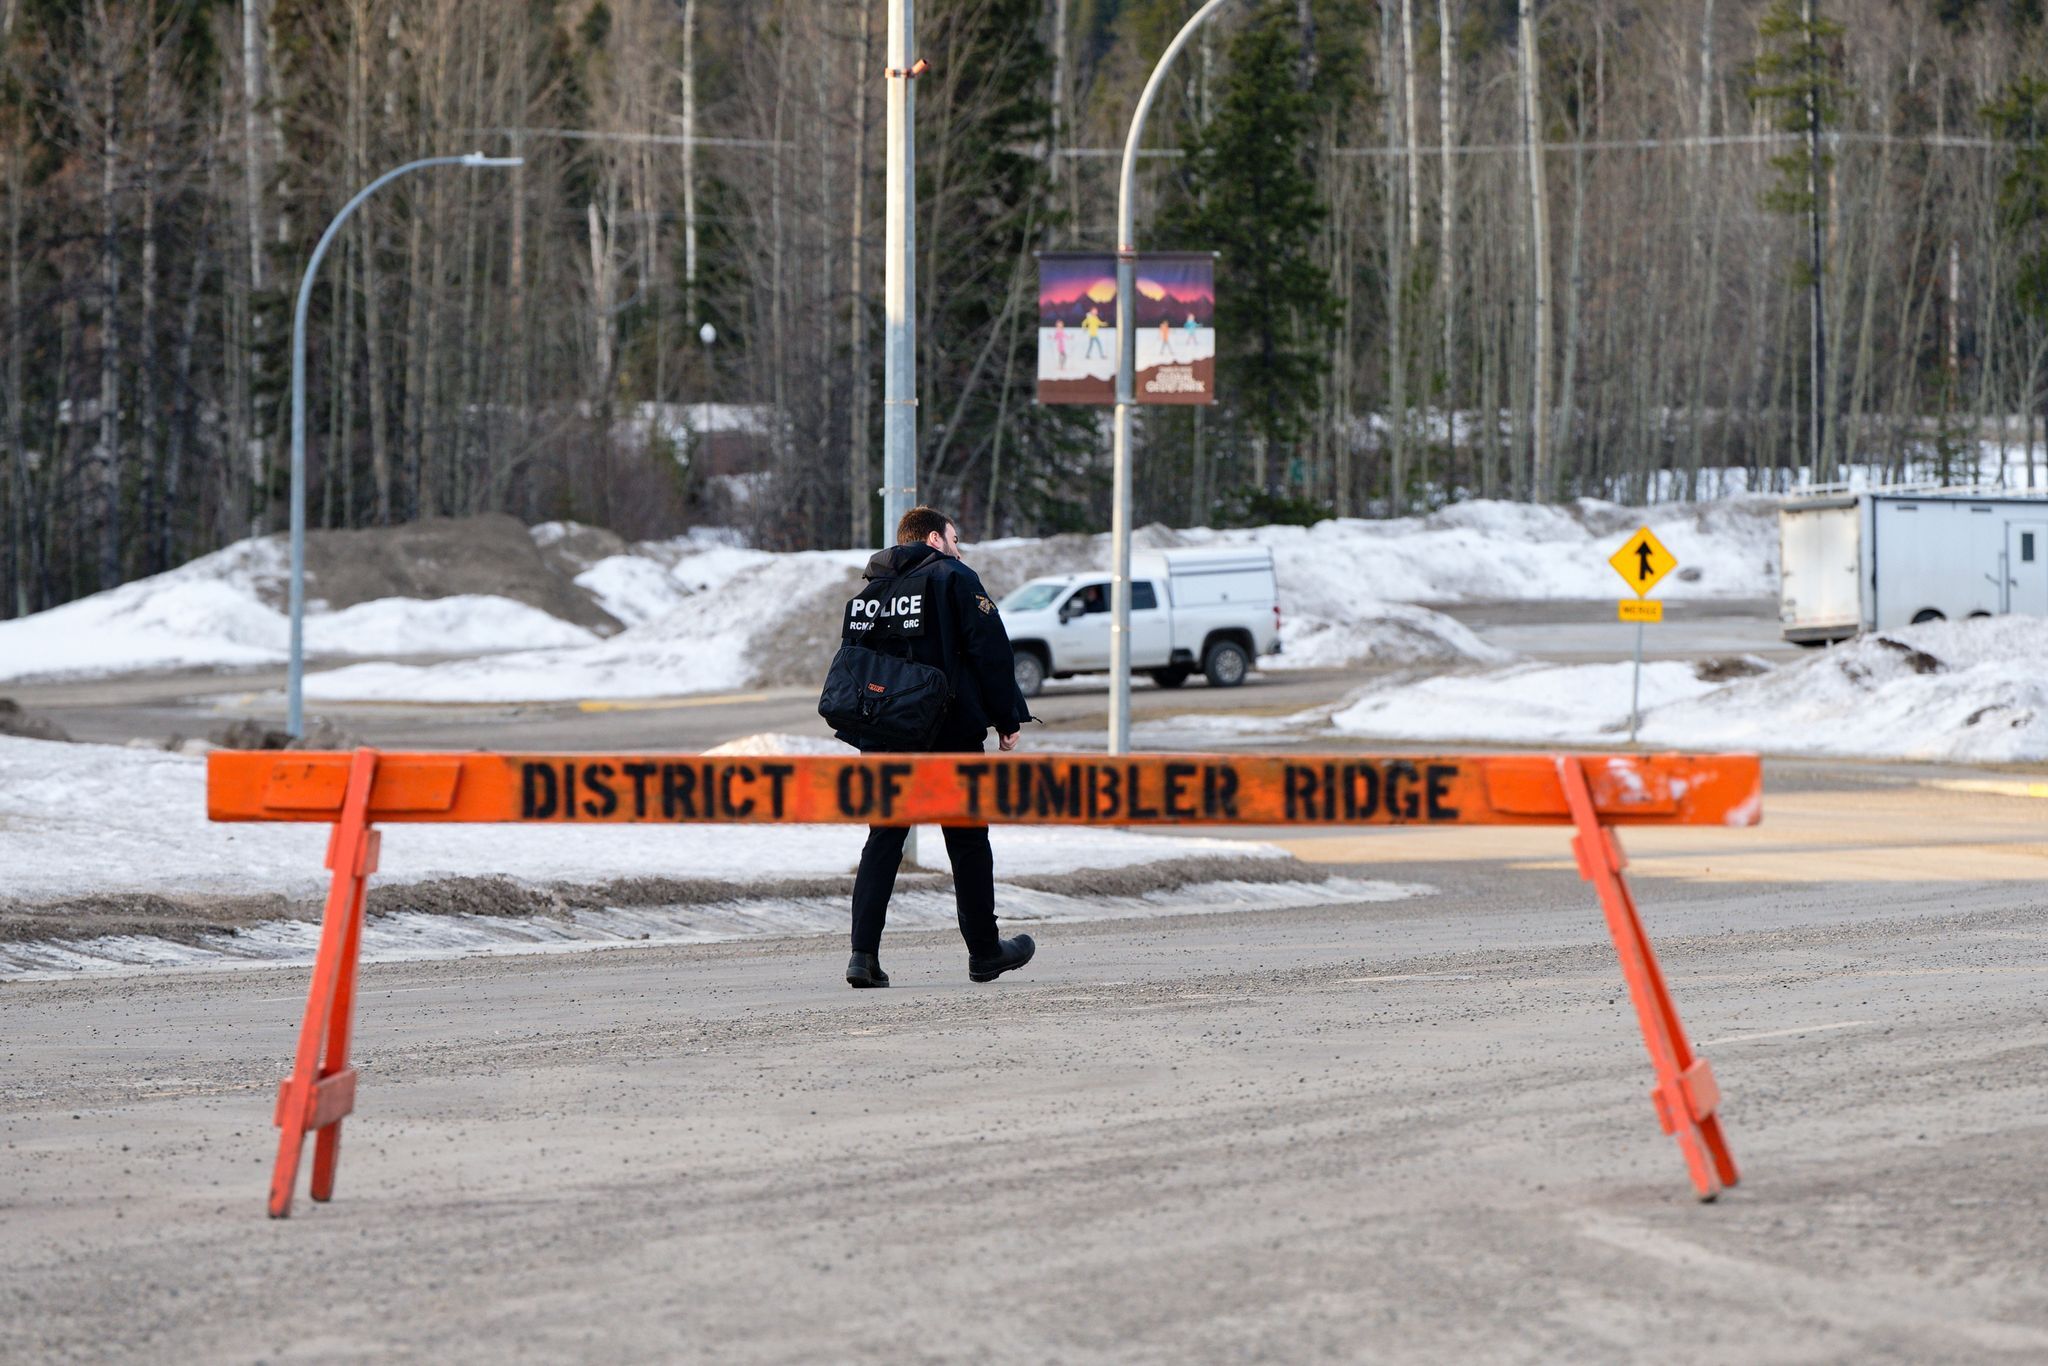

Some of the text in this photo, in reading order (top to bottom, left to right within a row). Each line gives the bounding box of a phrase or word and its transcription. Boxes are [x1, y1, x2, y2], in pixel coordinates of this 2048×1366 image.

[903, 619, 920, 629] GRC
[522, 763, 1460, 820] DISTRICT OF TUMBLER RIDGE
